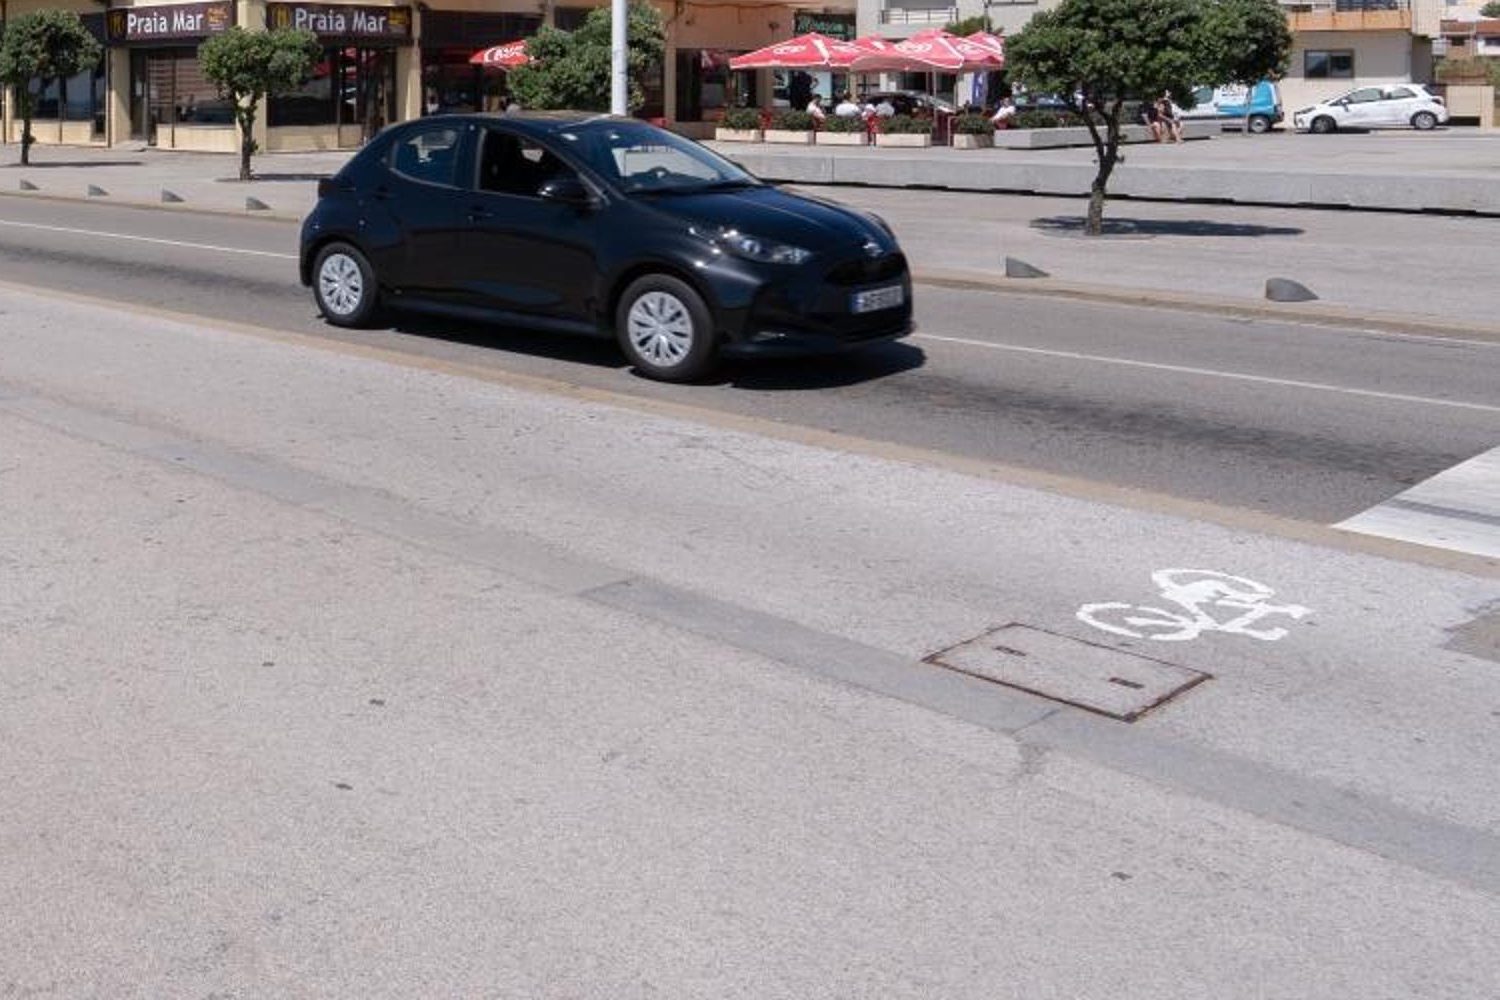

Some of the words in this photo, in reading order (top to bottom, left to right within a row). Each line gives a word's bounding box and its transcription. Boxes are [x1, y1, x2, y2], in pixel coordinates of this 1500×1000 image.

[127, 11, 168, 34] Praia
[173, 9, 204, 32] Mar
[295, 8, 346, 32] Praia
[352, 10, 387, 32] Mar
